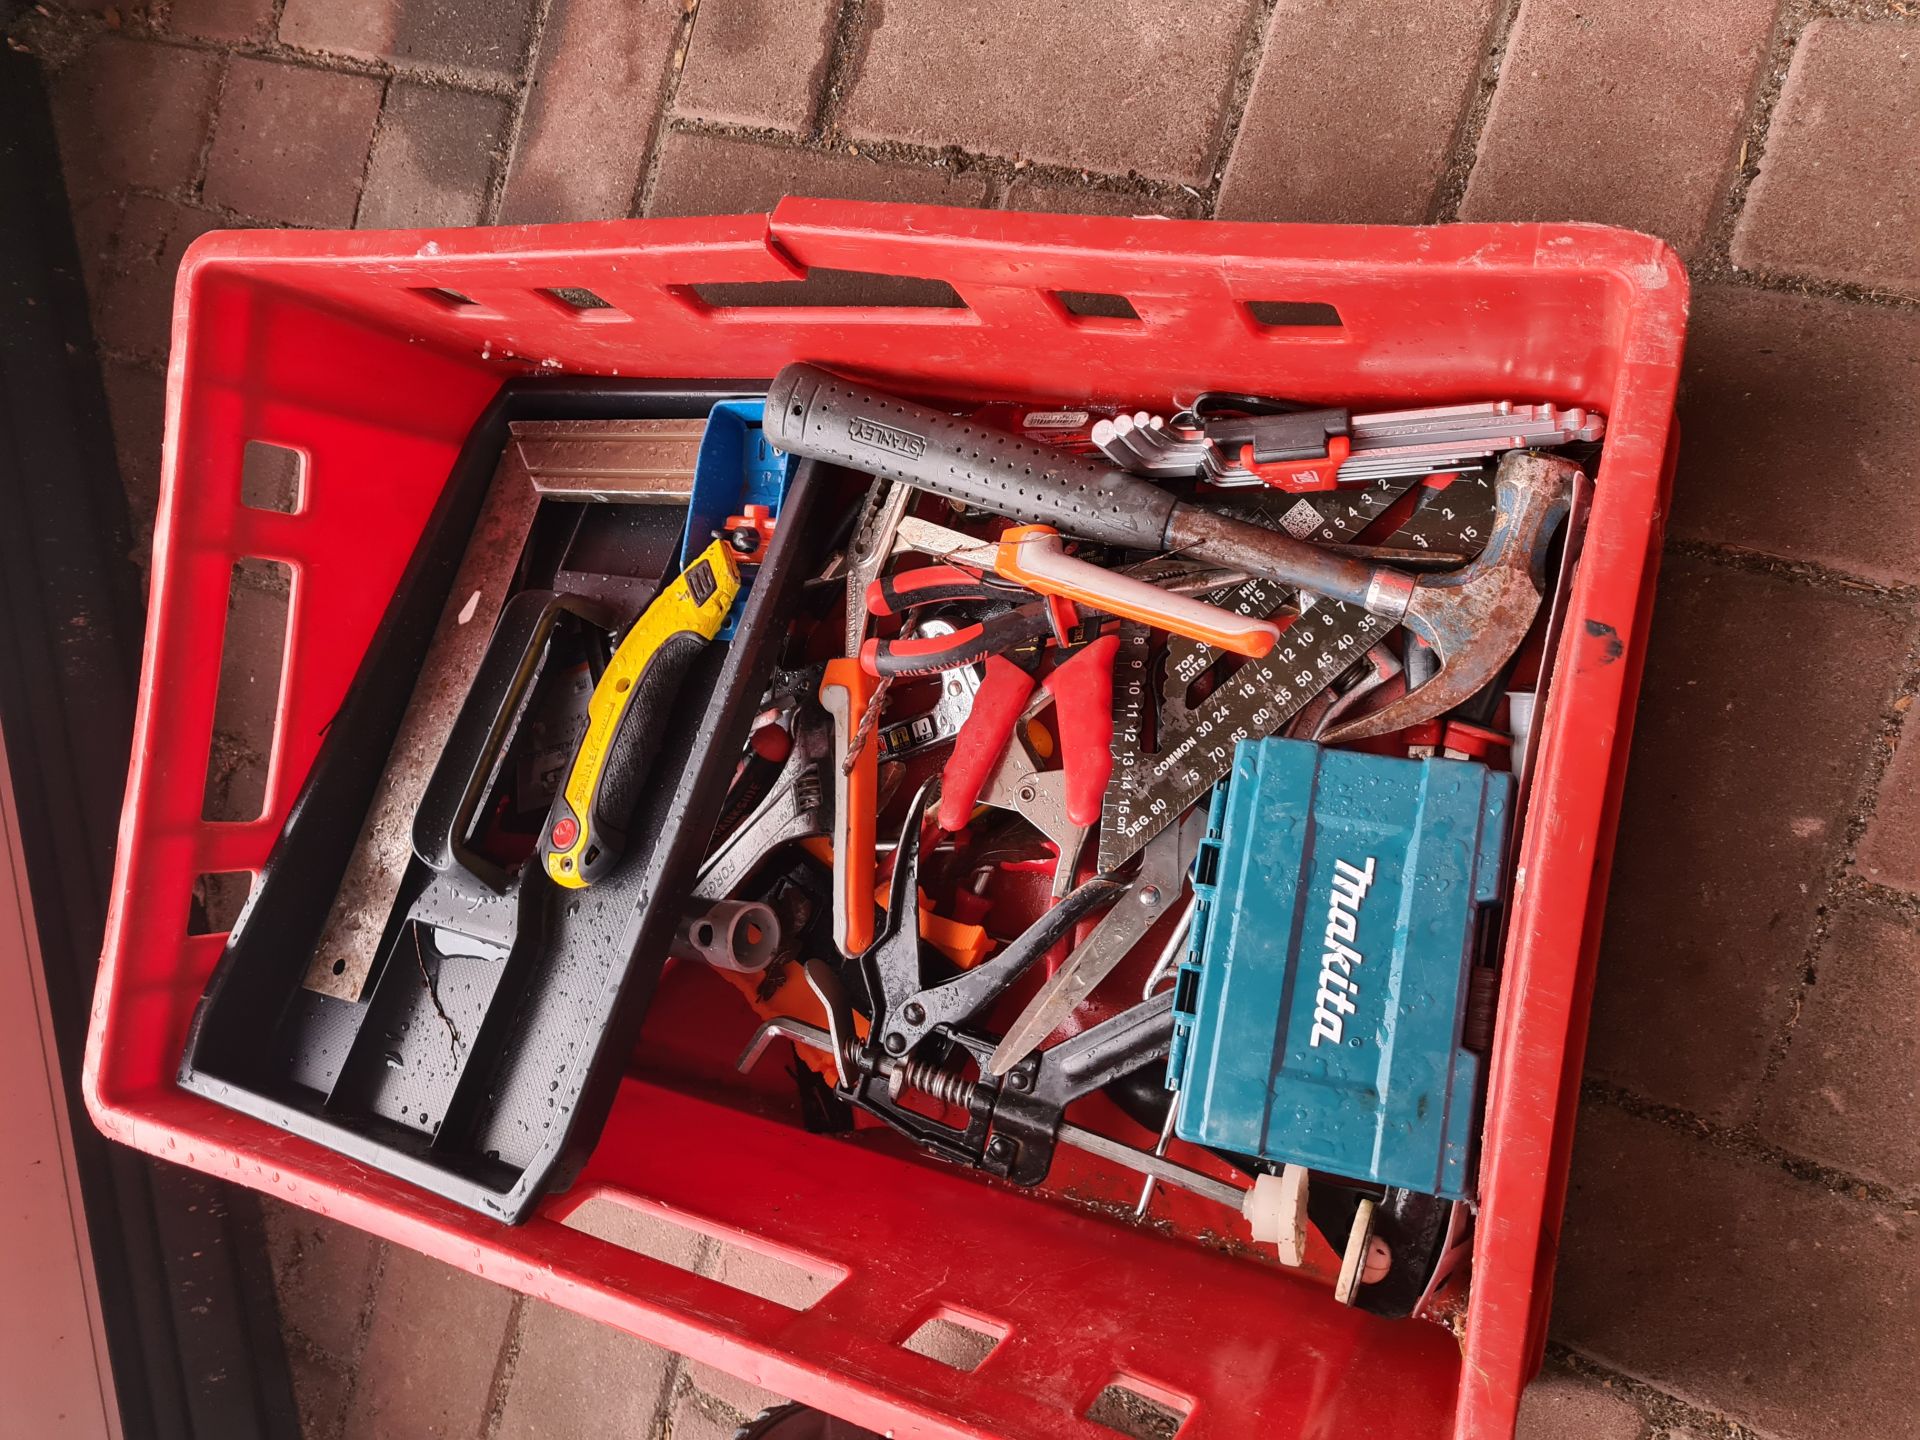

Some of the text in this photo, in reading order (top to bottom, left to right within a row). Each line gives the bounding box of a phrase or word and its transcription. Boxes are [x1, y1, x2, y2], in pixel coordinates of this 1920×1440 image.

[855, 423, 920, 455] STANLEY
[1322, 479, 1391, 539] 2 3 4 5 6
[1442, 508, 1455, 520] 2
[1459, 526, 1477, 542] 15
[1249, 589, 1265, 605] 15
[1174, 653, 1195, 674] TOP
[1180, 657, 1207, 682] CUTS
[1153, 601, 1347, 777] COMMON 30 24 18 15 12 10 8 7
[1116, 636, 1145, 834] 8 9 10 11 12 13 14 15 cm
[1125, 613, 1376, 838] DEG. 80 75 70 65 60 55 50 45 40 35
